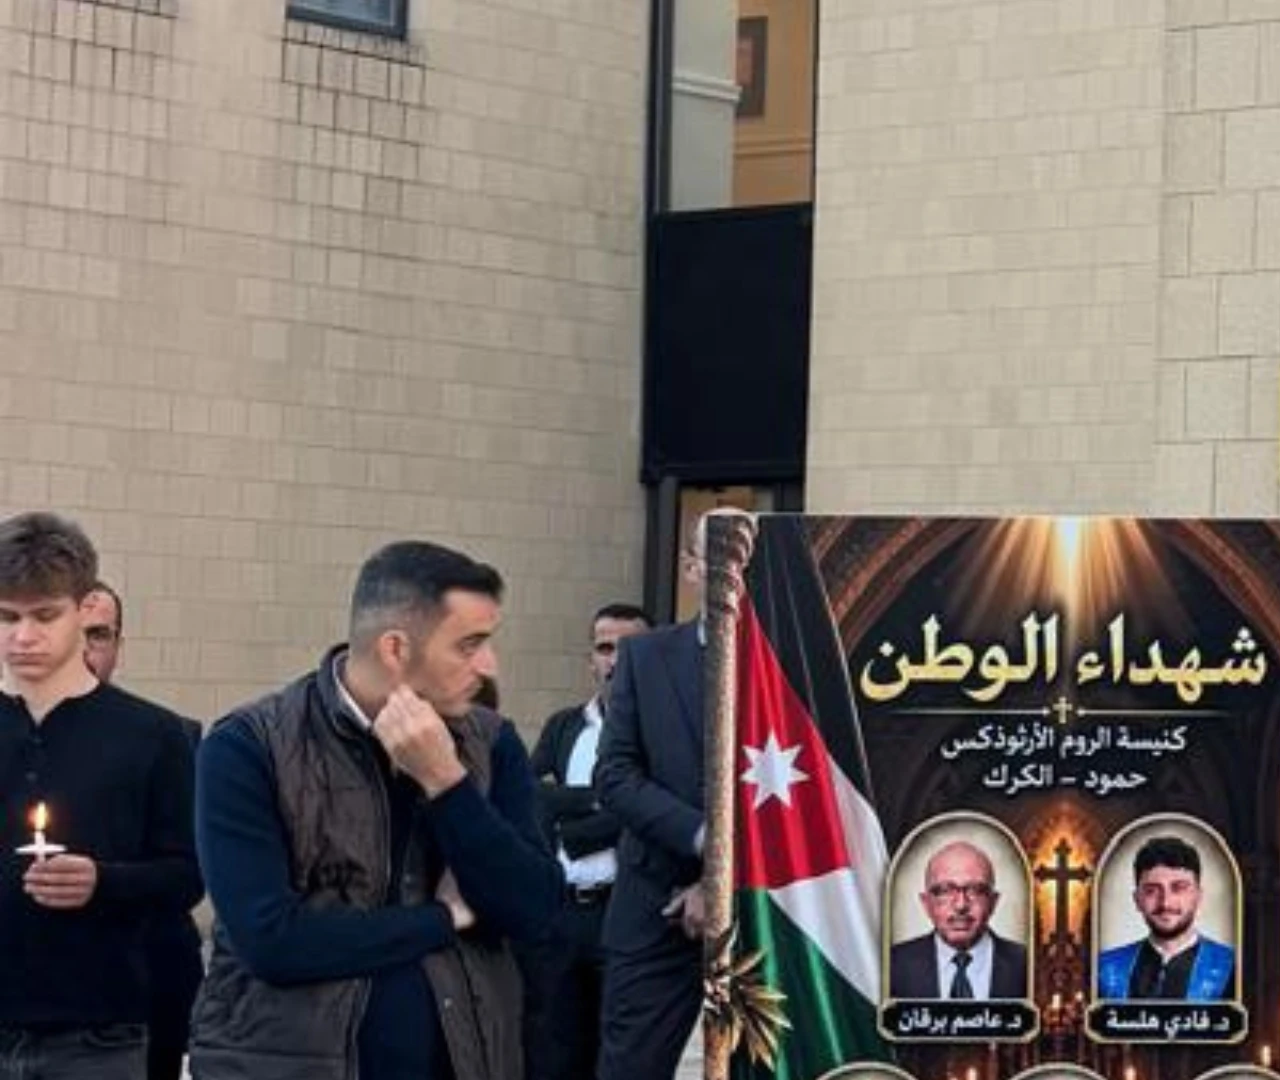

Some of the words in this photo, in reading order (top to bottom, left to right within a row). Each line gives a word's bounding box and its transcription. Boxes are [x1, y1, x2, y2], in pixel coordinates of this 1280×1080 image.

[860, 612, 1059, 702] الوطن
[1076, 613, 1268, 703] شهداء
[940, 722, 1055, 759] الأرثوذكس
[1059, 725, 1111, 760] الروم
[1119, 724, 1188, 759] كنيسة
[983, 764, 1054, 795] الكرك
[1084, 767, 1147, 794] حمود
[898, 1007, 949, 1034] برقان
[950, 1008, 1003, 1034] عاصم
[1106, 1008, 1160, 1030] هلسة
[1164, 1009, 1211, 1039] فادي
